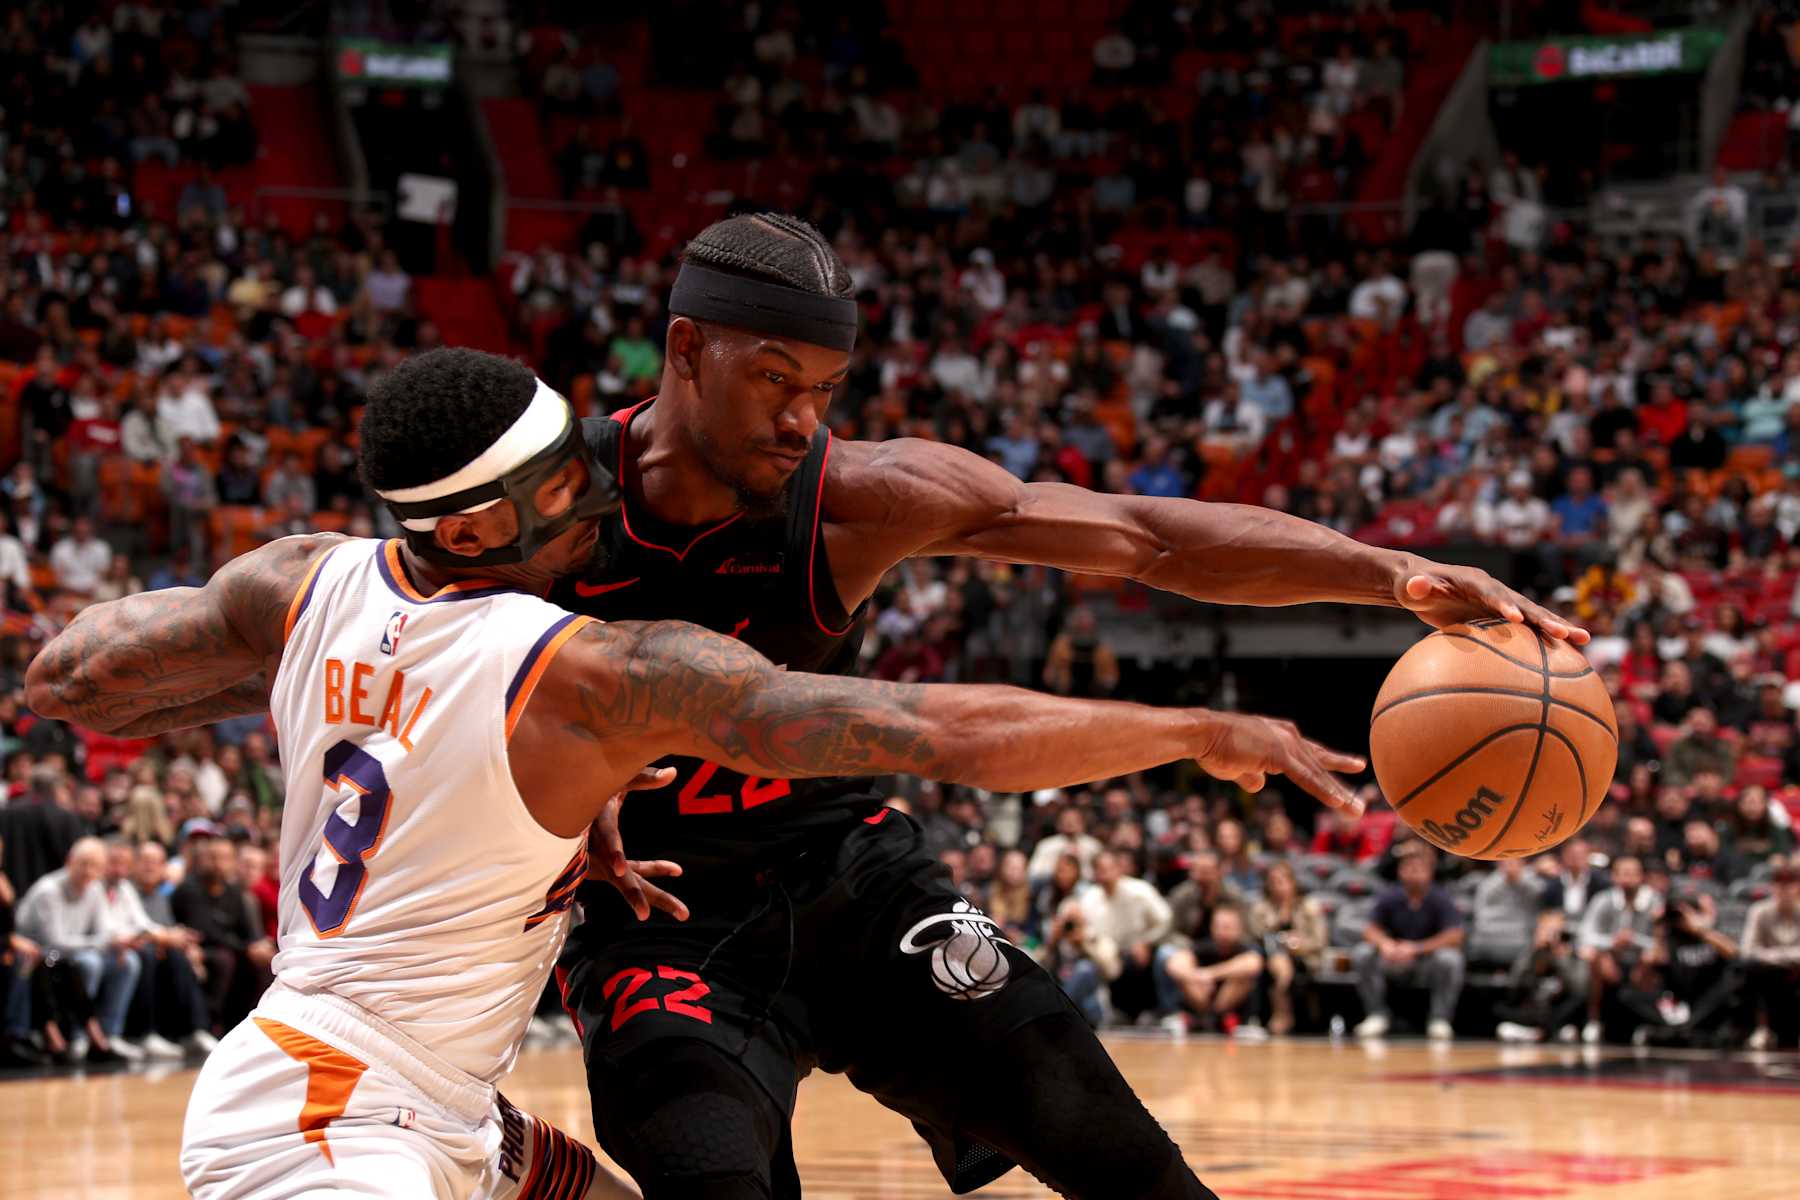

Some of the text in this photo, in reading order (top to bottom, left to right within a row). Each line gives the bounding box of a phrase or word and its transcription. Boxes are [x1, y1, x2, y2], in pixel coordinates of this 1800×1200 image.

[325, 659, 433, 753] BEAL
[298, 739, 394, 940] 3
[602, 965, 713, 1032] 22
